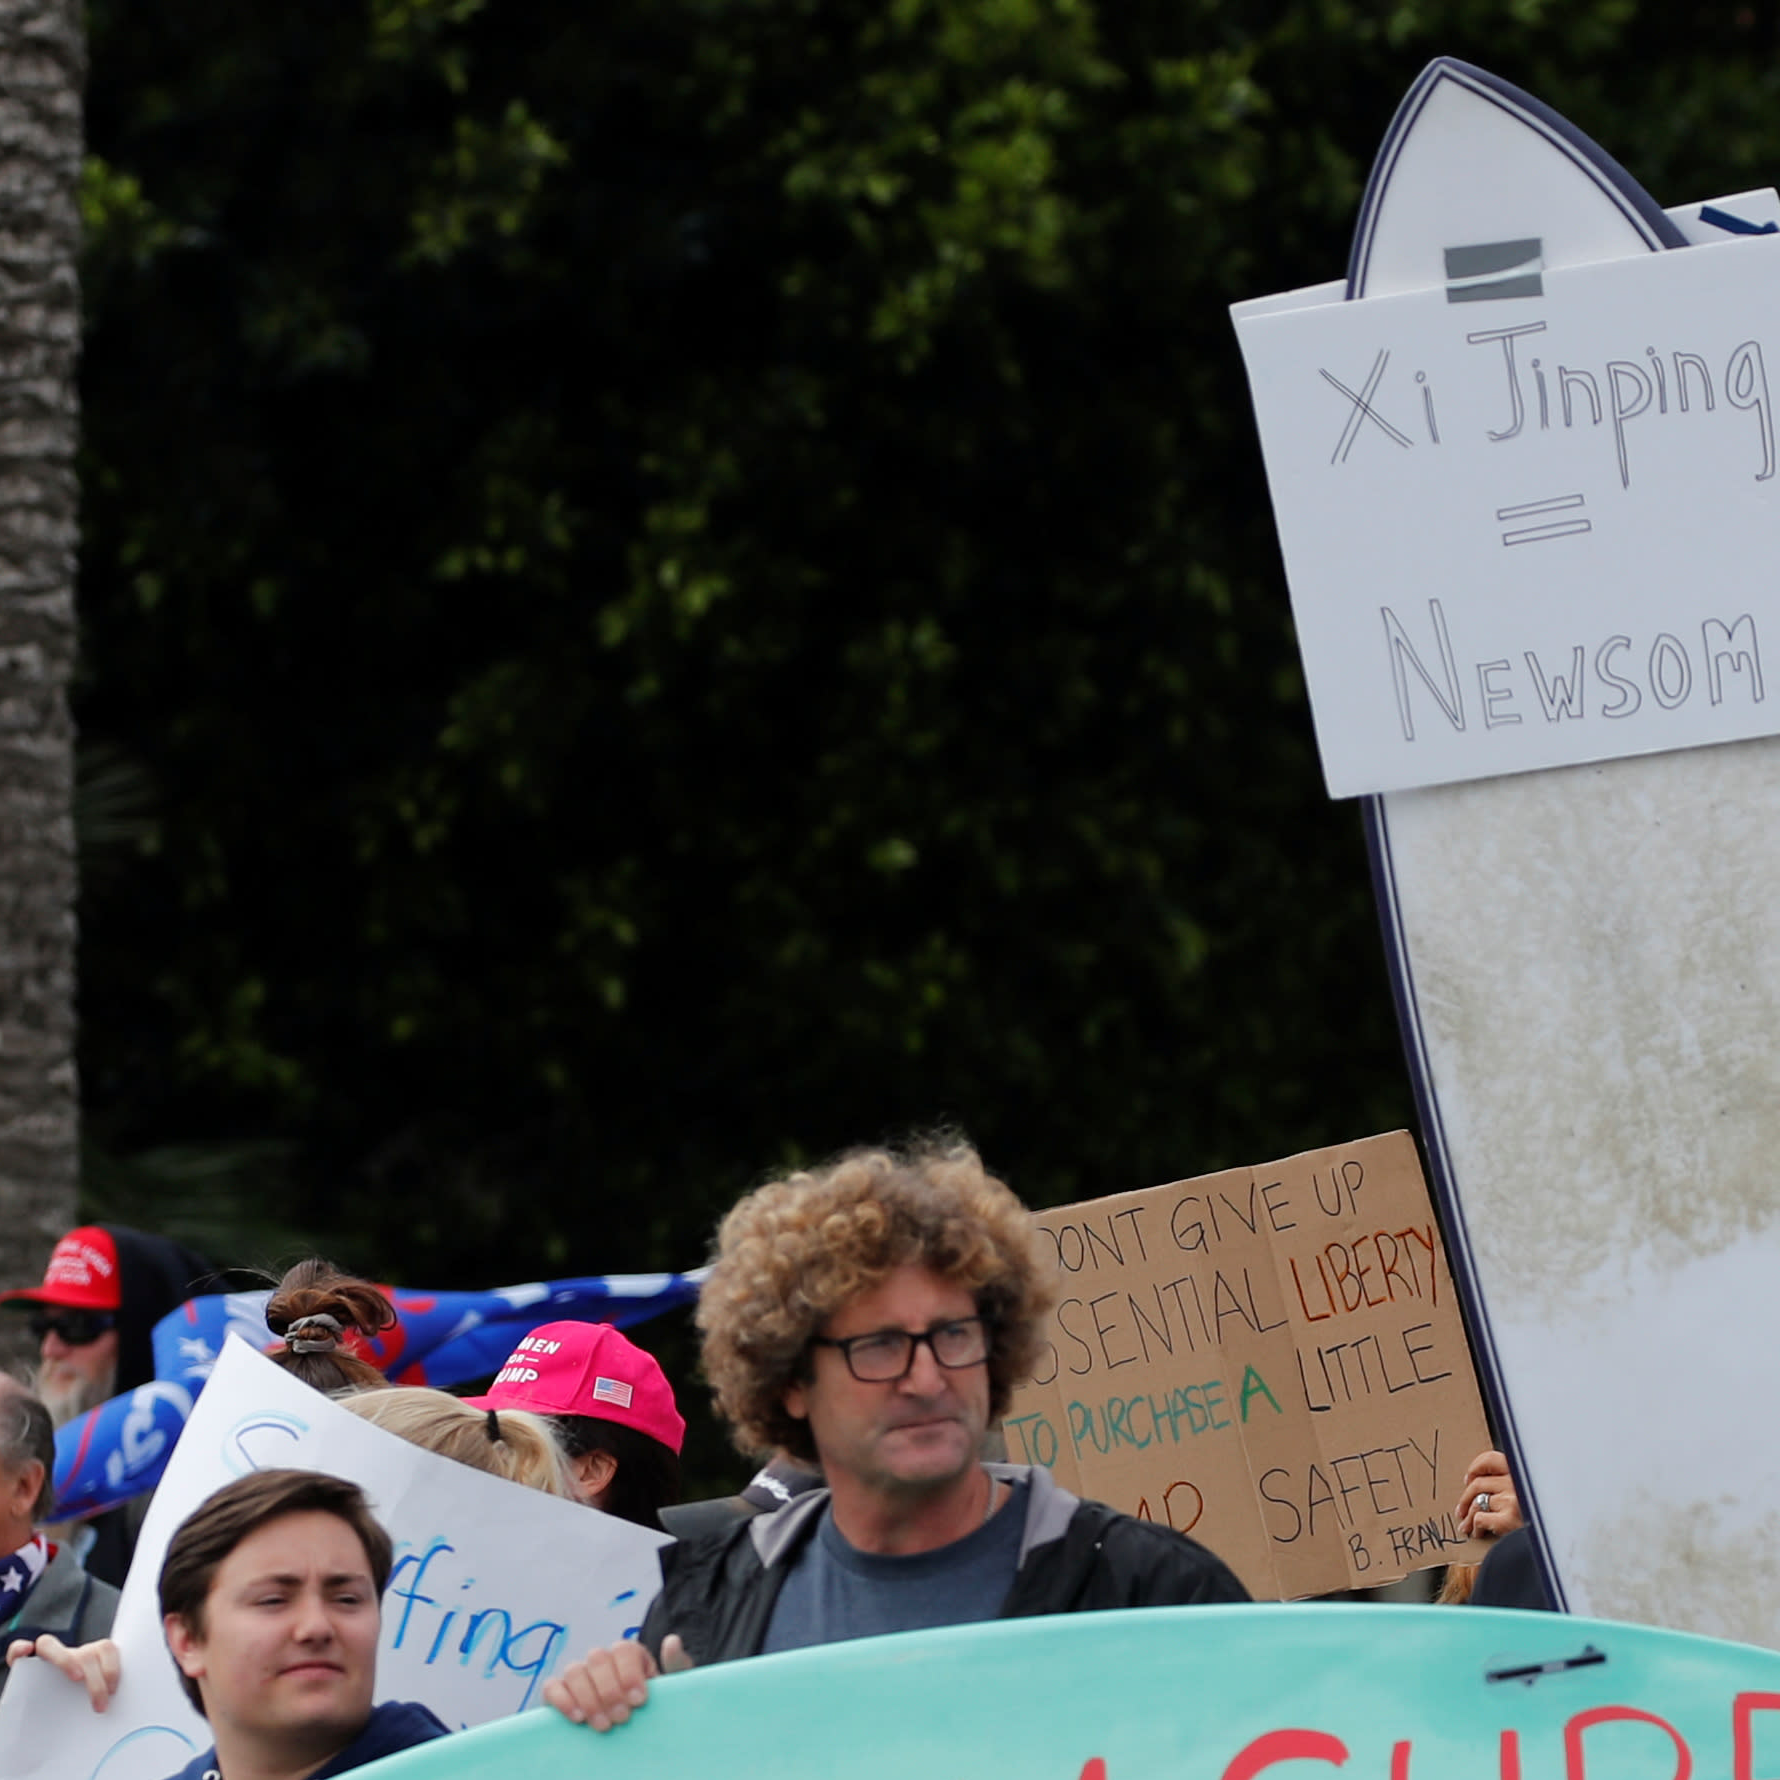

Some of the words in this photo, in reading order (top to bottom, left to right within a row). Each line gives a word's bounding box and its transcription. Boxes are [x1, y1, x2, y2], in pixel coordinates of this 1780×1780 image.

[1319, 348, 1441, 466] Xi
[1467, 321, 1776, 490] Jinping
[1170, 1182, 1297, 1255] GIVE
[1312, 1160, 1364, 1217] UP
[1014, 1268, 1289, 1390] SSENTIAL
[1288, 1223, 1438, 1323] LIBERTY
[1004, 1411, 1059, 1470] TO
[1067, 1380, 1233, 1461] PURCHASE
[1238, 1363, 1284, 1425] A
[1295, 1323, 1453, 1413] LITTLE
[1258, 1428, 1440, 1544] SAFETY
